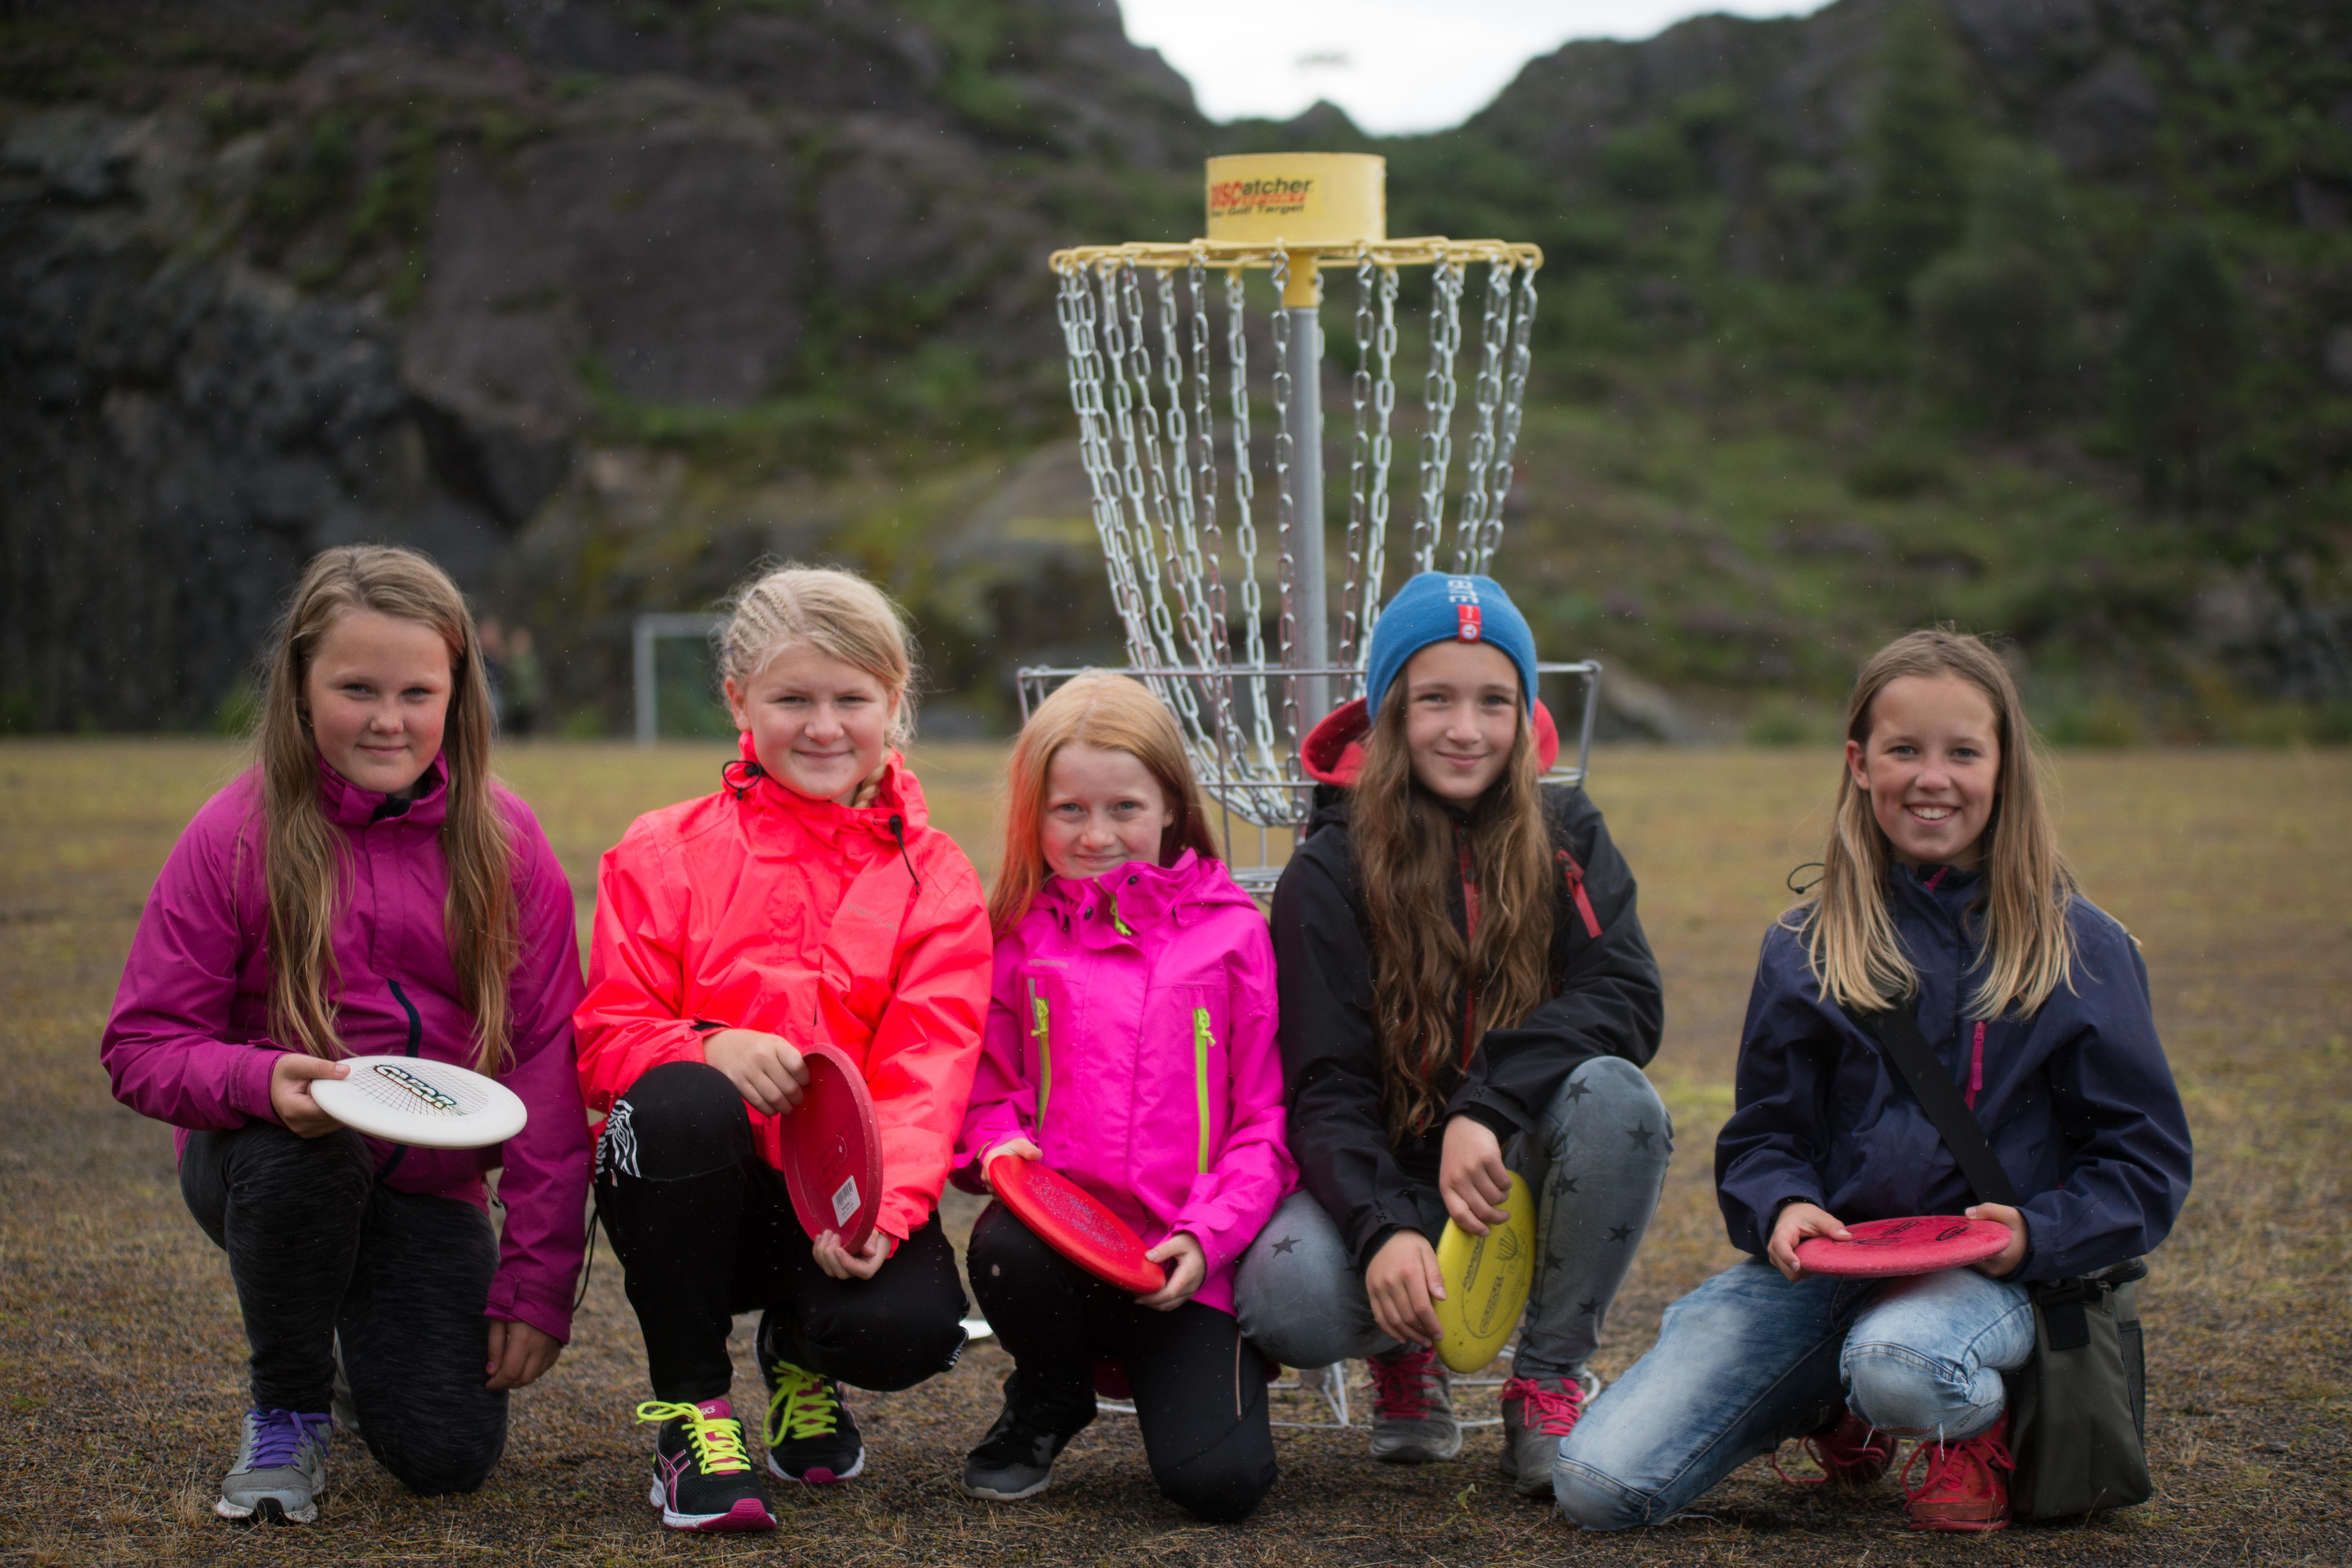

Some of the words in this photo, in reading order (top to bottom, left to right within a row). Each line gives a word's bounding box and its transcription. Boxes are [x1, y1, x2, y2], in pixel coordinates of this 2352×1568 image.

[1257, 204, 1305, 215] Target
[848, 903, 899, 933] VERTICAL
[700, 1405, 715, 1416] SICS
